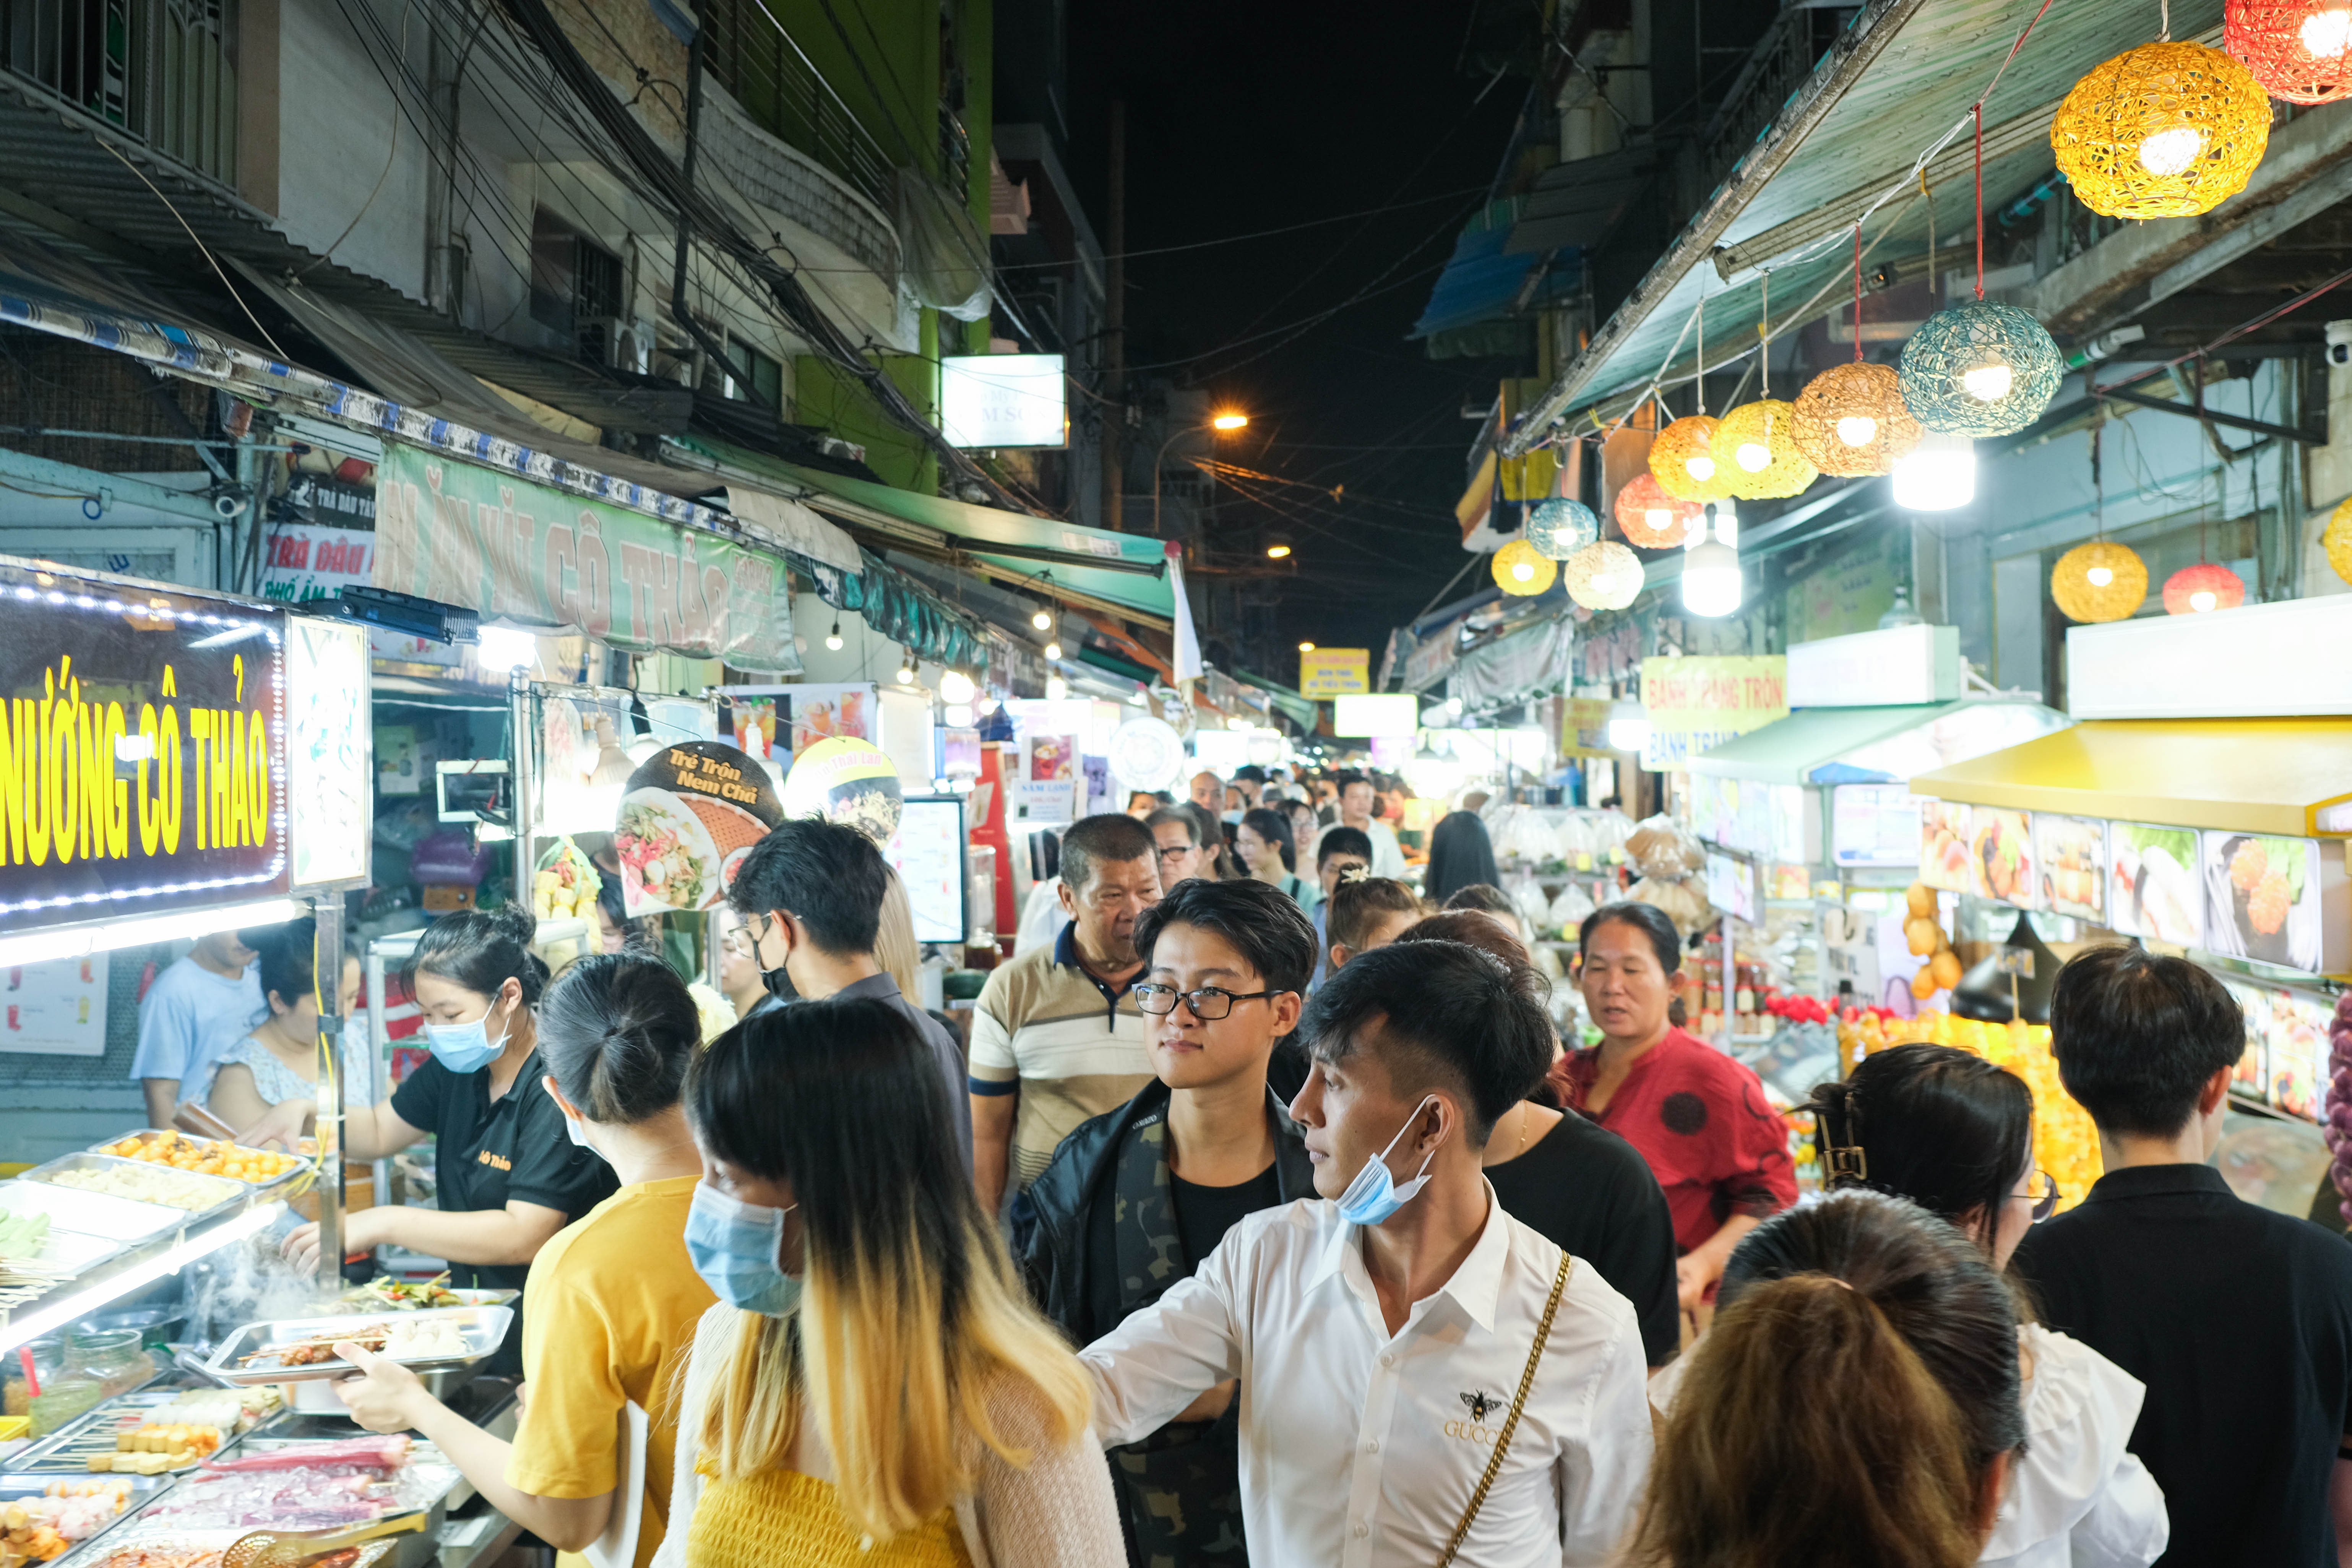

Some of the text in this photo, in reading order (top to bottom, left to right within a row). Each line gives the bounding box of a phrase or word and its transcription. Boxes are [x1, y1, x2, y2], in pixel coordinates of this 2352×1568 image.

[544, 509, 611, 638] CÔ
[620, 531, 730, 652] THẢO
[0, 654, 268, 866] NƯỚNG CÔ THẢO
[670, 748, 742, 781] Tré Trộn
[676, 770, 721, 795] Nem
